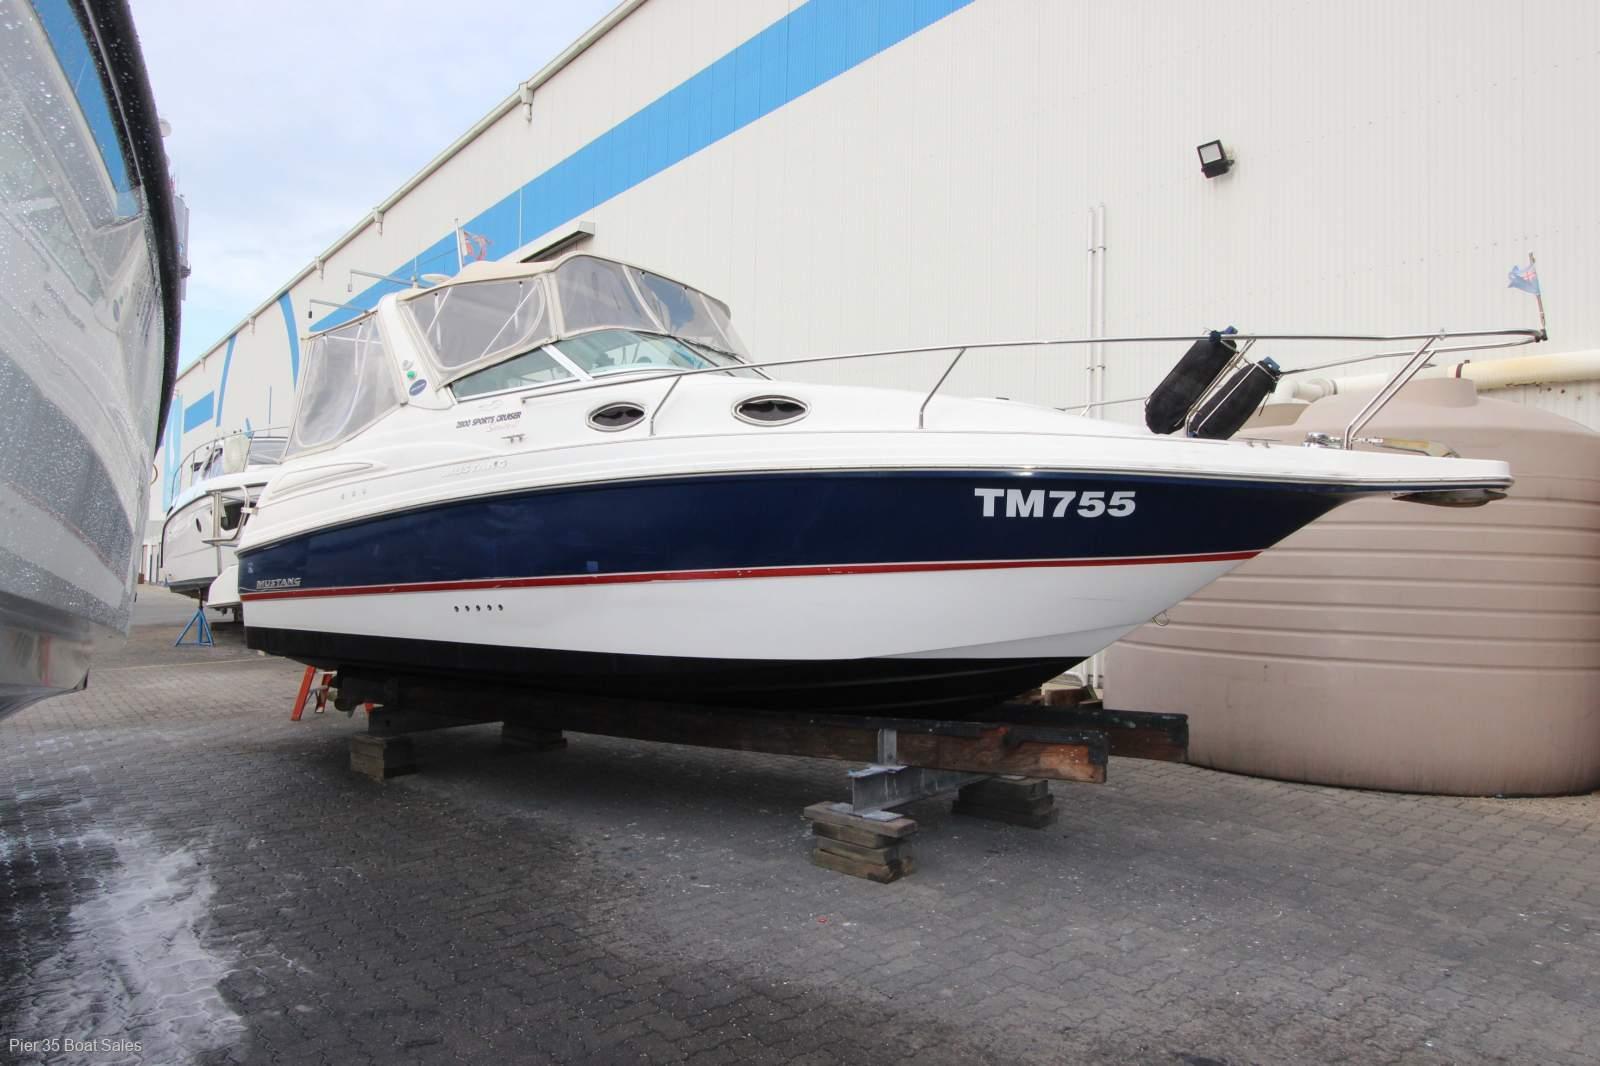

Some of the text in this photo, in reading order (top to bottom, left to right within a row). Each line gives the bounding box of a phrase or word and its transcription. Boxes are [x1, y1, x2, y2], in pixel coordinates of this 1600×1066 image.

[472, 415, 495, 426] SPORTS
[496, 411, 522, 423] CRUISER
[974, 487, 1137, 518] TM755
[256, 577, 302, 590] MUSTANG
